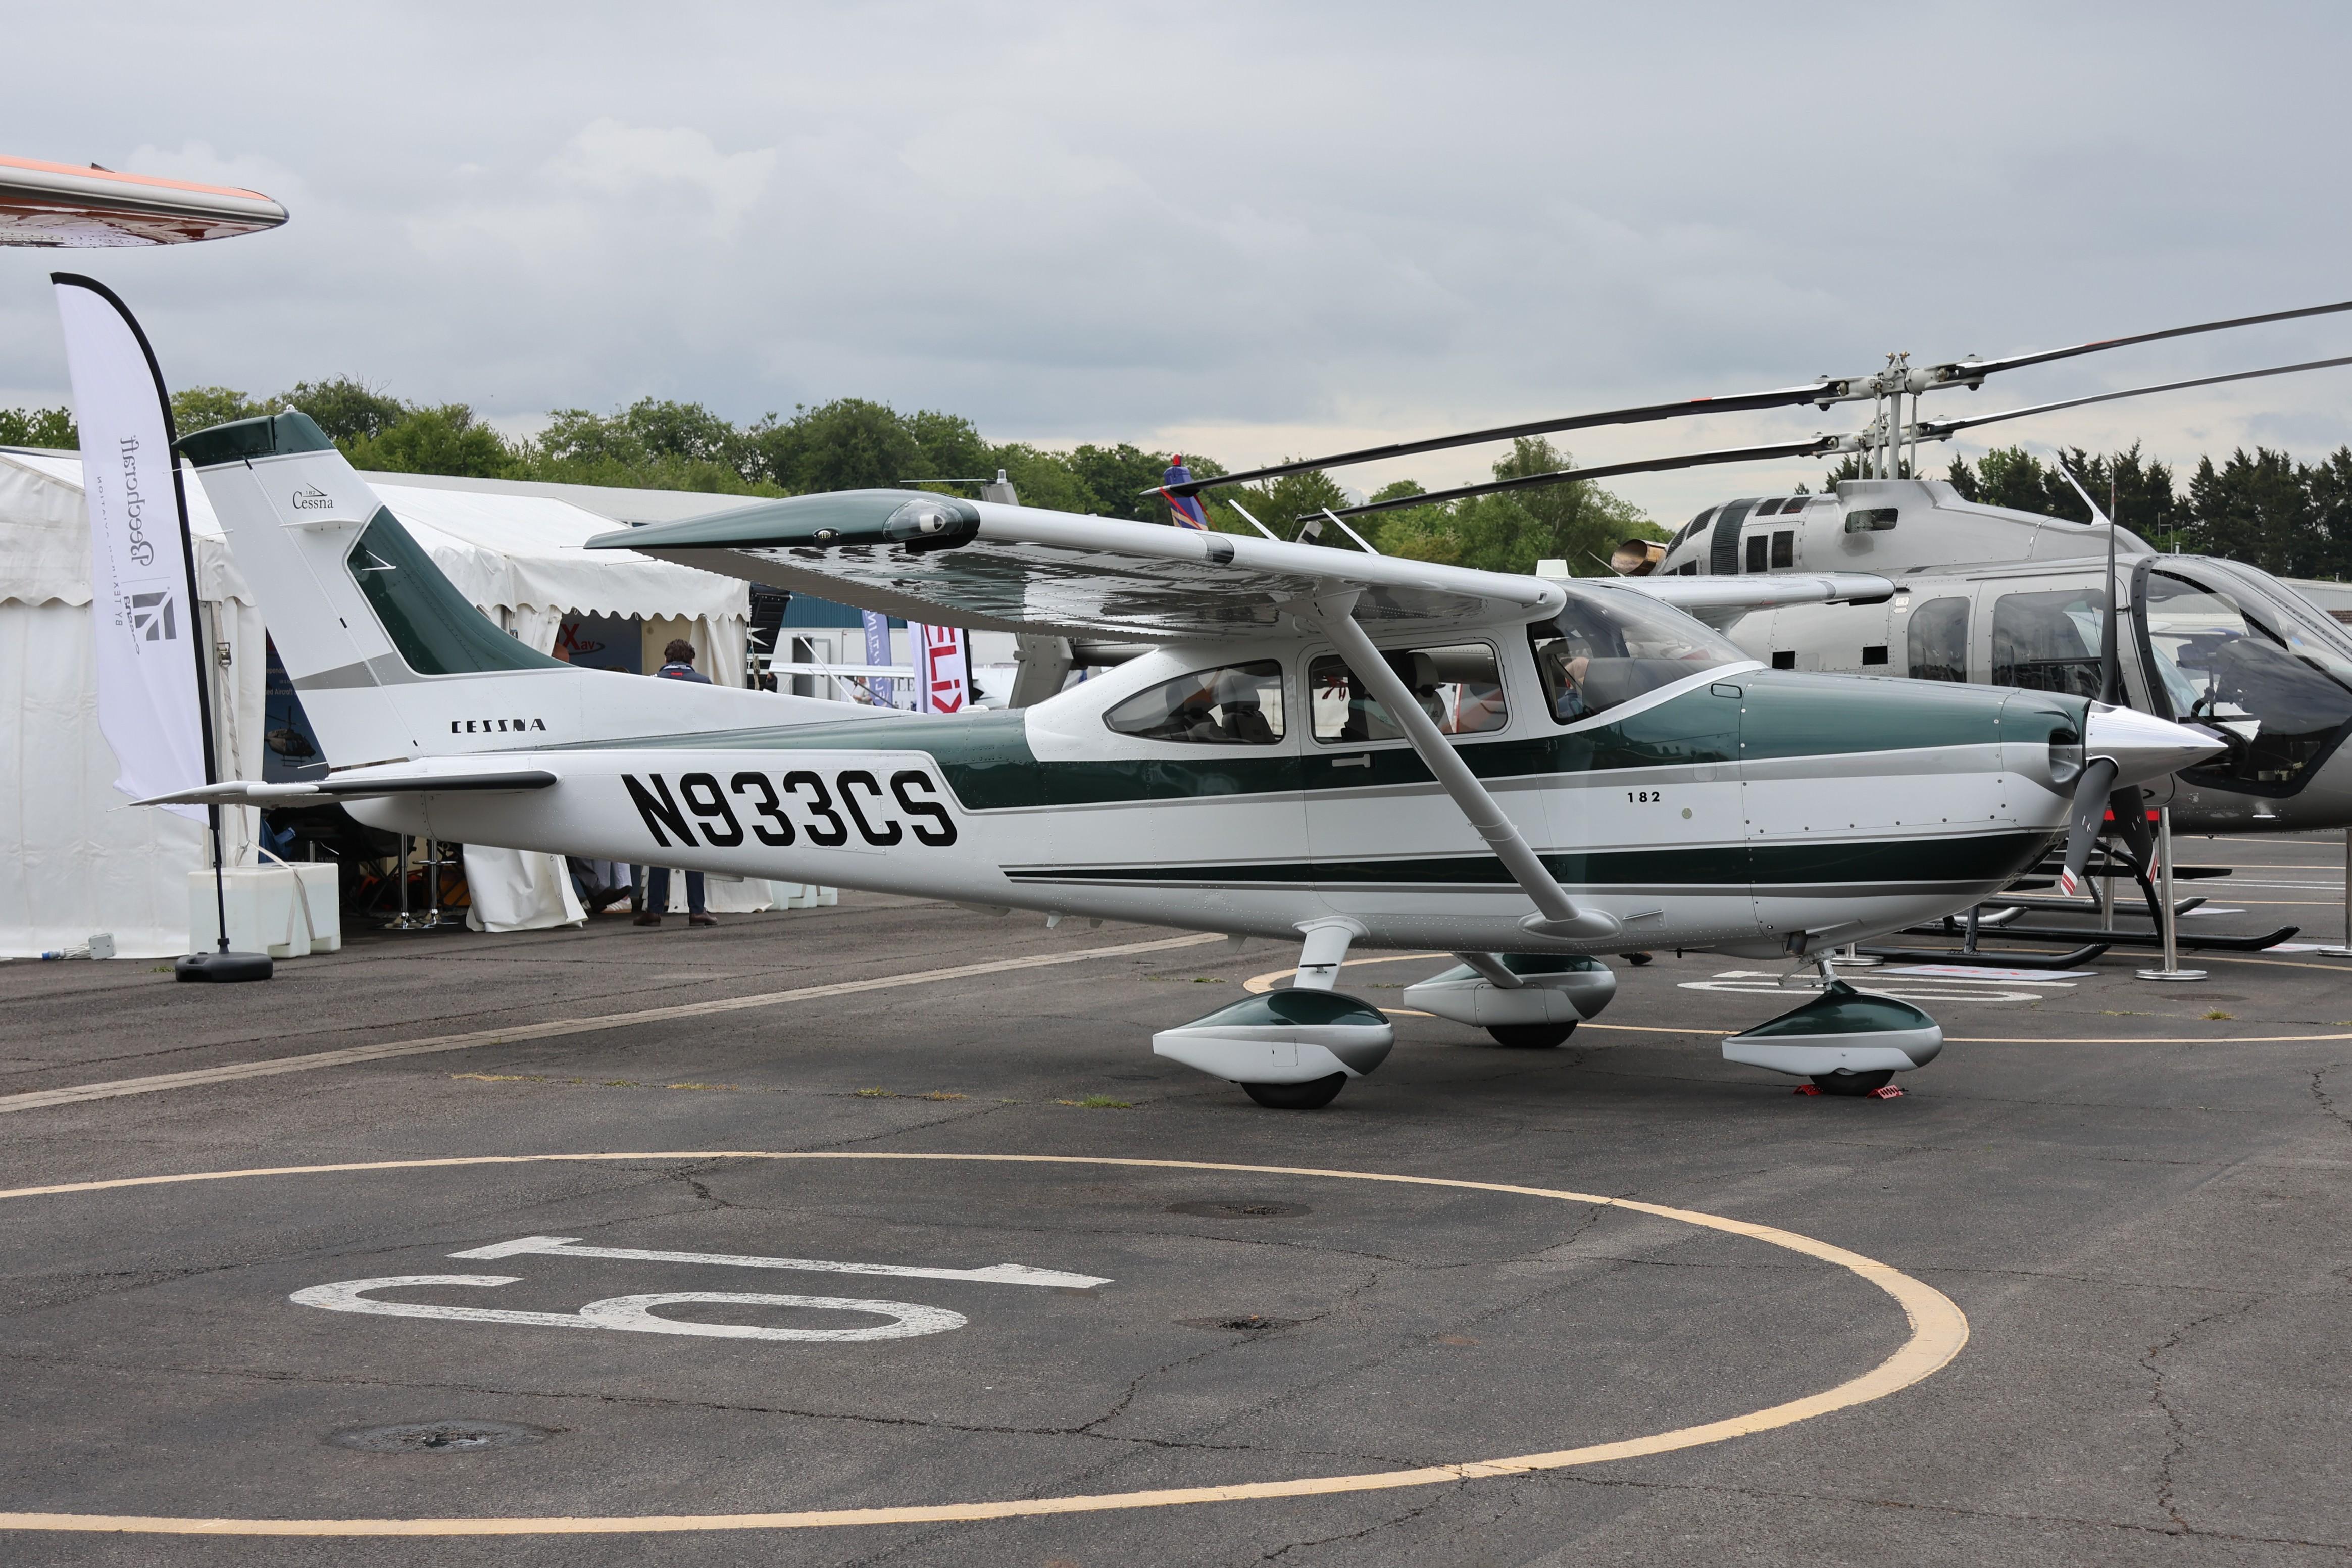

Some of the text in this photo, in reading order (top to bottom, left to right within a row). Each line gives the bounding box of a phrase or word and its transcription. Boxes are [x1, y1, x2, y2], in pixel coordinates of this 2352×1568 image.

[293, 491, 333, 509] Cessna
[452, 718, 546, 733] CESSNA
[1627, 791, 1660, 803] 182
[621, 770, 958, 847] N933CS
